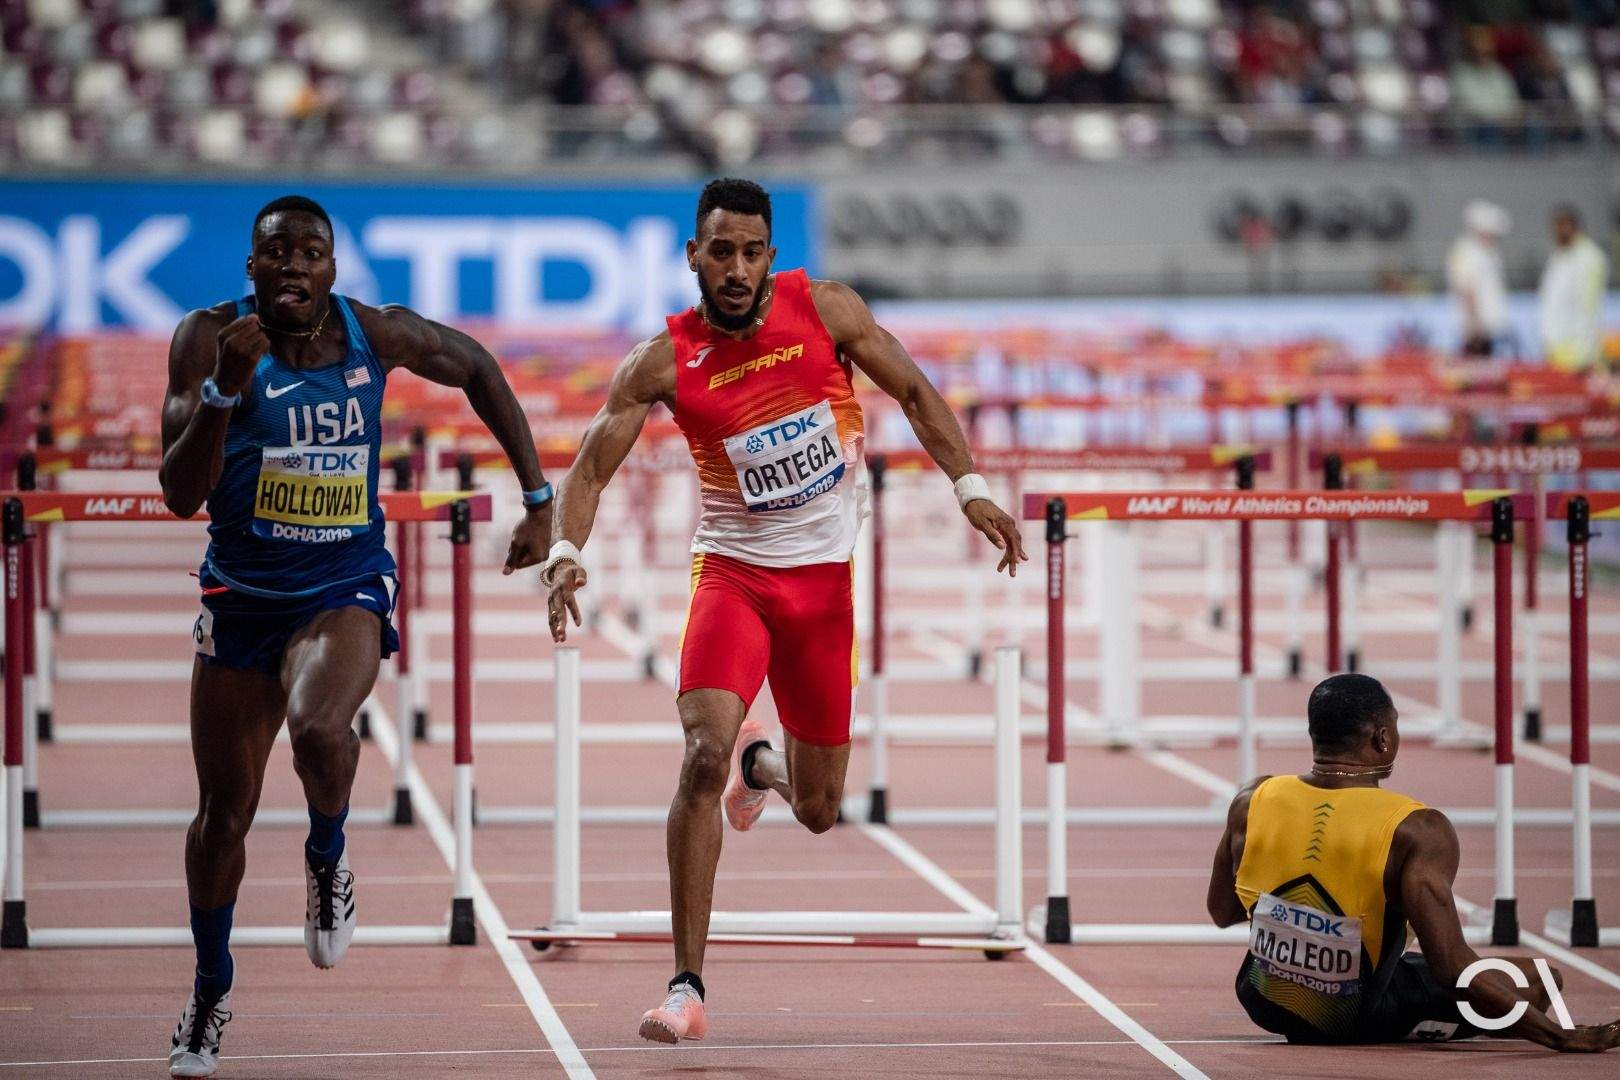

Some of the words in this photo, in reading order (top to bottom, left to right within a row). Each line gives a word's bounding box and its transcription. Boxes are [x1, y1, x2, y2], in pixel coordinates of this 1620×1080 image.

[708, 343, 804, 391] ESPAÑA
[287, 397, 365, 446] USA
[760, 411, 820, 447] TDK
[303, 453, 358, 471] TDK
[744, 435, 838, 497] ORTEGA
[84, 498, 136, 515] IAAF
[260, 480, 364, 516] HOLLOWAY
[1126, 496, 1178, 514] IAAF
[1180, 496, 1230, 514] World
[1231, 496, 1301, 514] Athletics
[1304, 495, 1430, 517] Championships
[272, 522, 353, 543] DOHA2019
[1289, 907, 1344, 938] TDK
[1254, 927, 1352, 974] McLEOD
[1267, 963, 1341, 995] DOHA2019
